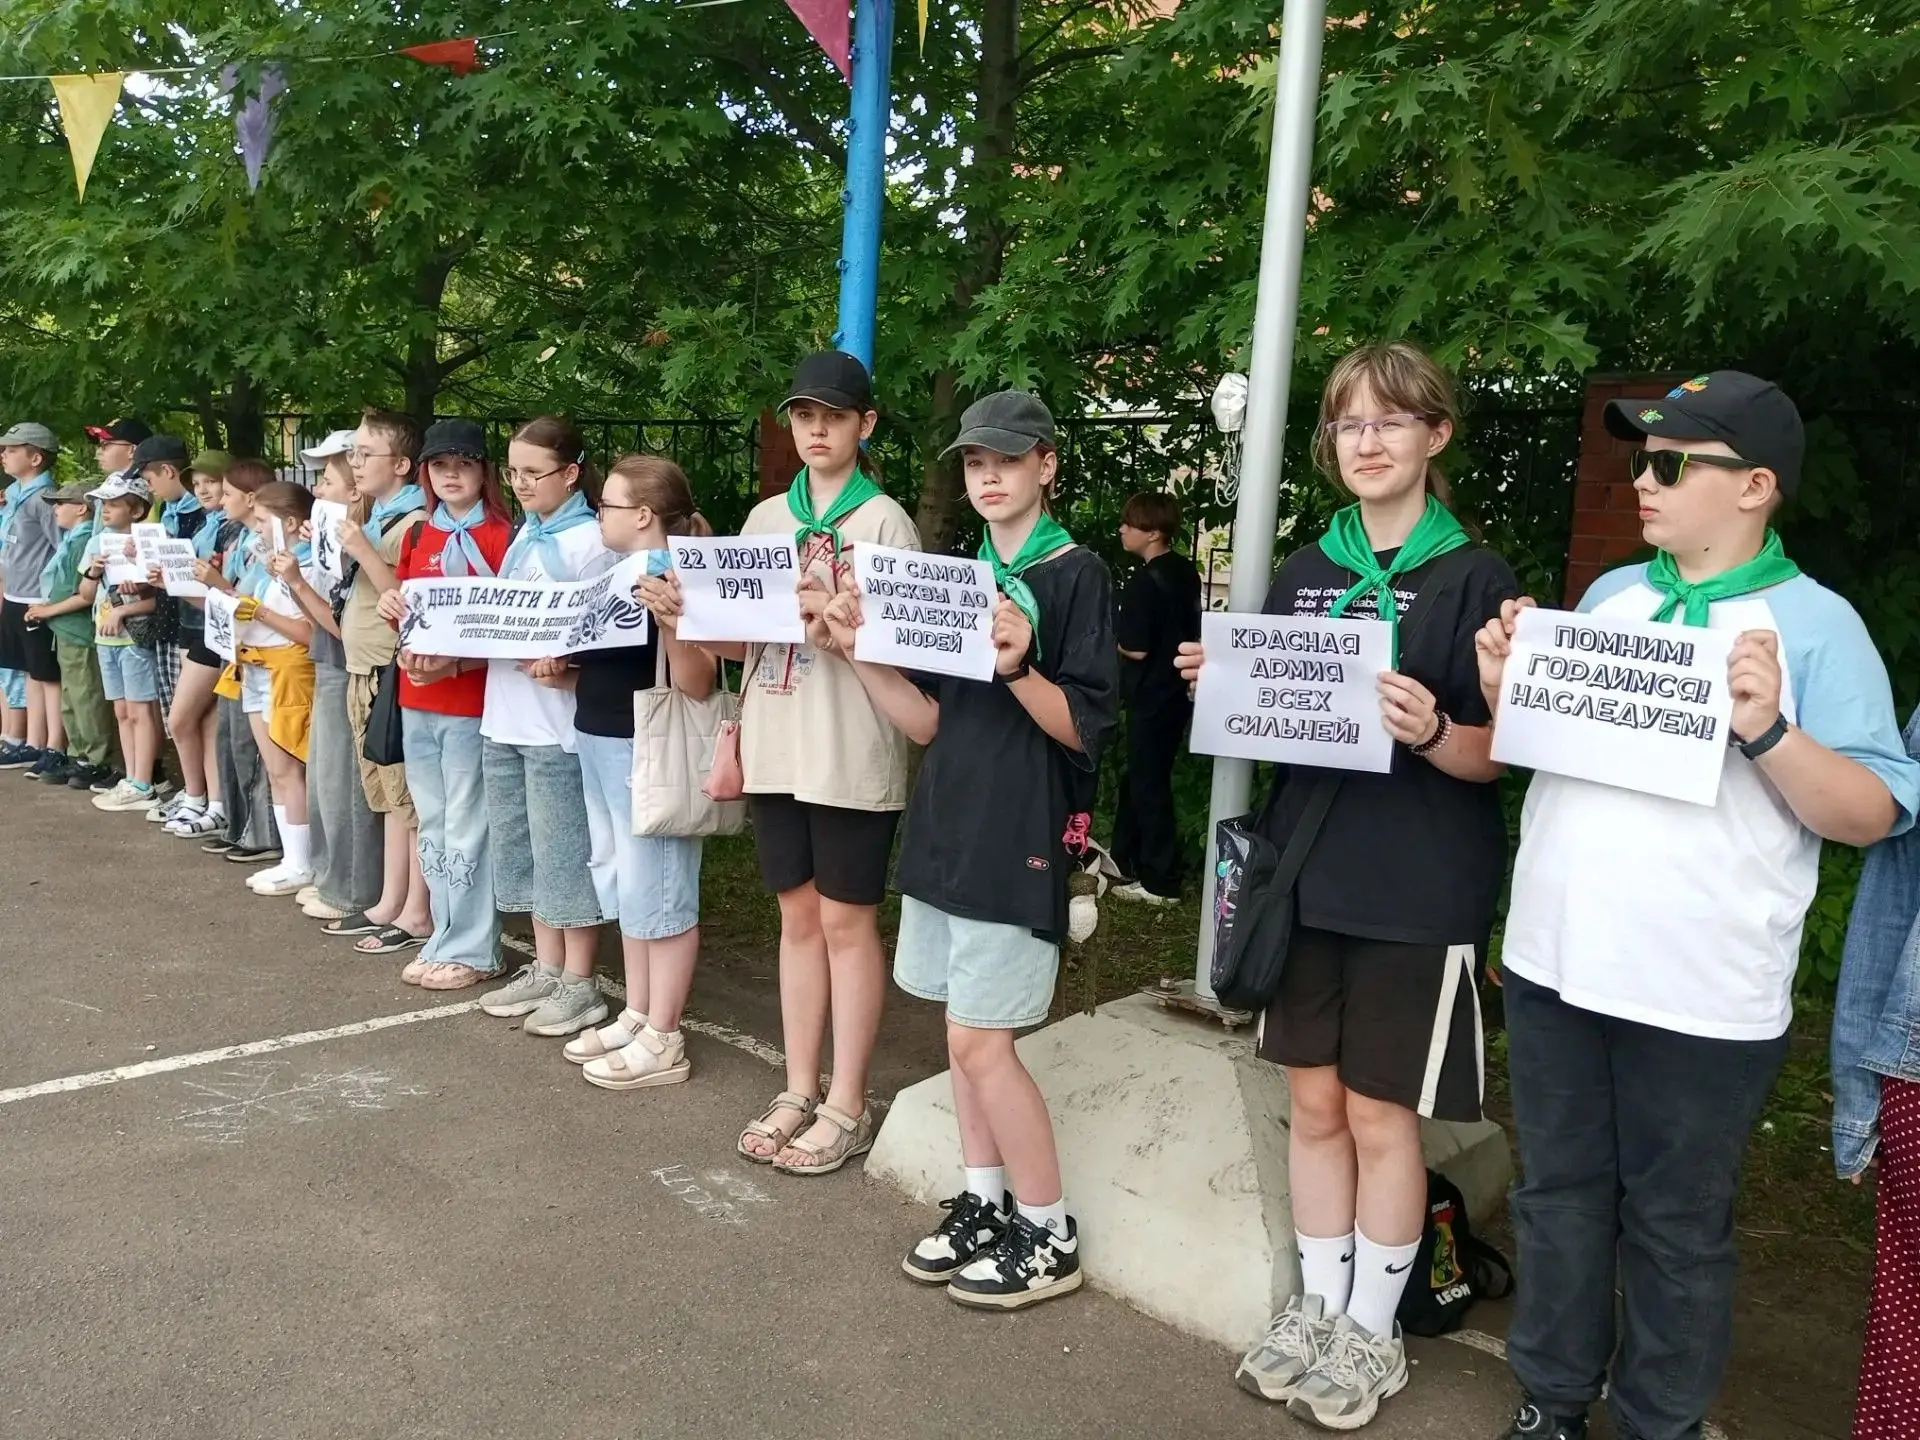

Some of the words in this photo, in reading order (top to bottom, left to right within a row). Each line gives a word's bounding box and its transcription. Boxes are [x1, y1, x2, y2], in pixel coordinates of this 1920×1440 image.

[679, 548, 706, 570] 22
[715, 547, 793, 570] ИЮНЯ
[871, 554, 896, 575] ОТ
[905, 560, 977, 586] САМОЙ
[427, 586, 462, 609] ДЕНЬ
[467, 587, 545, 609] ПАМЯТИ
[547, 591, 565, 609] И
[716, 578, 765, 600] 1941
[865, 577, 951, 604] МОСКВЫ
[960, 589, 988, 608] ДО
[1296, 587, 1321, 598] chipi
[1294, 598, 1317, 608] dubi
[453, 612, 500, 627] ГОДОВЩИНА
[503, 614, 541, 628] НАЧАЛА
[881, 602, 979, 631] ДАЛЕКИХ
[459, 627, 529, 642] ОТЕЧЕСТВЕННОЙ
[530, 629, 561, 642] ВОЙНЫ
[895, 627, 963, 654] МОРЕЙ
[1231, 628, 1360, 655] КРАСНАЯ
[1554, 625, 1695, 667] ПОМНИМ!
[1250, 657, 1345, 683] АРМИЯ
[1528, 653, 1712, 705] ГОРДИМСЯ!
[1257, 686, 1333, 712] ВСЕХ
[1510, 682, 1717, 741] НАСЛЕДУЕМ!
[1225, 713, 1361, 744] СИЛЬНЕЙ!
[1435, 1284, 1471, 1306] LEON
